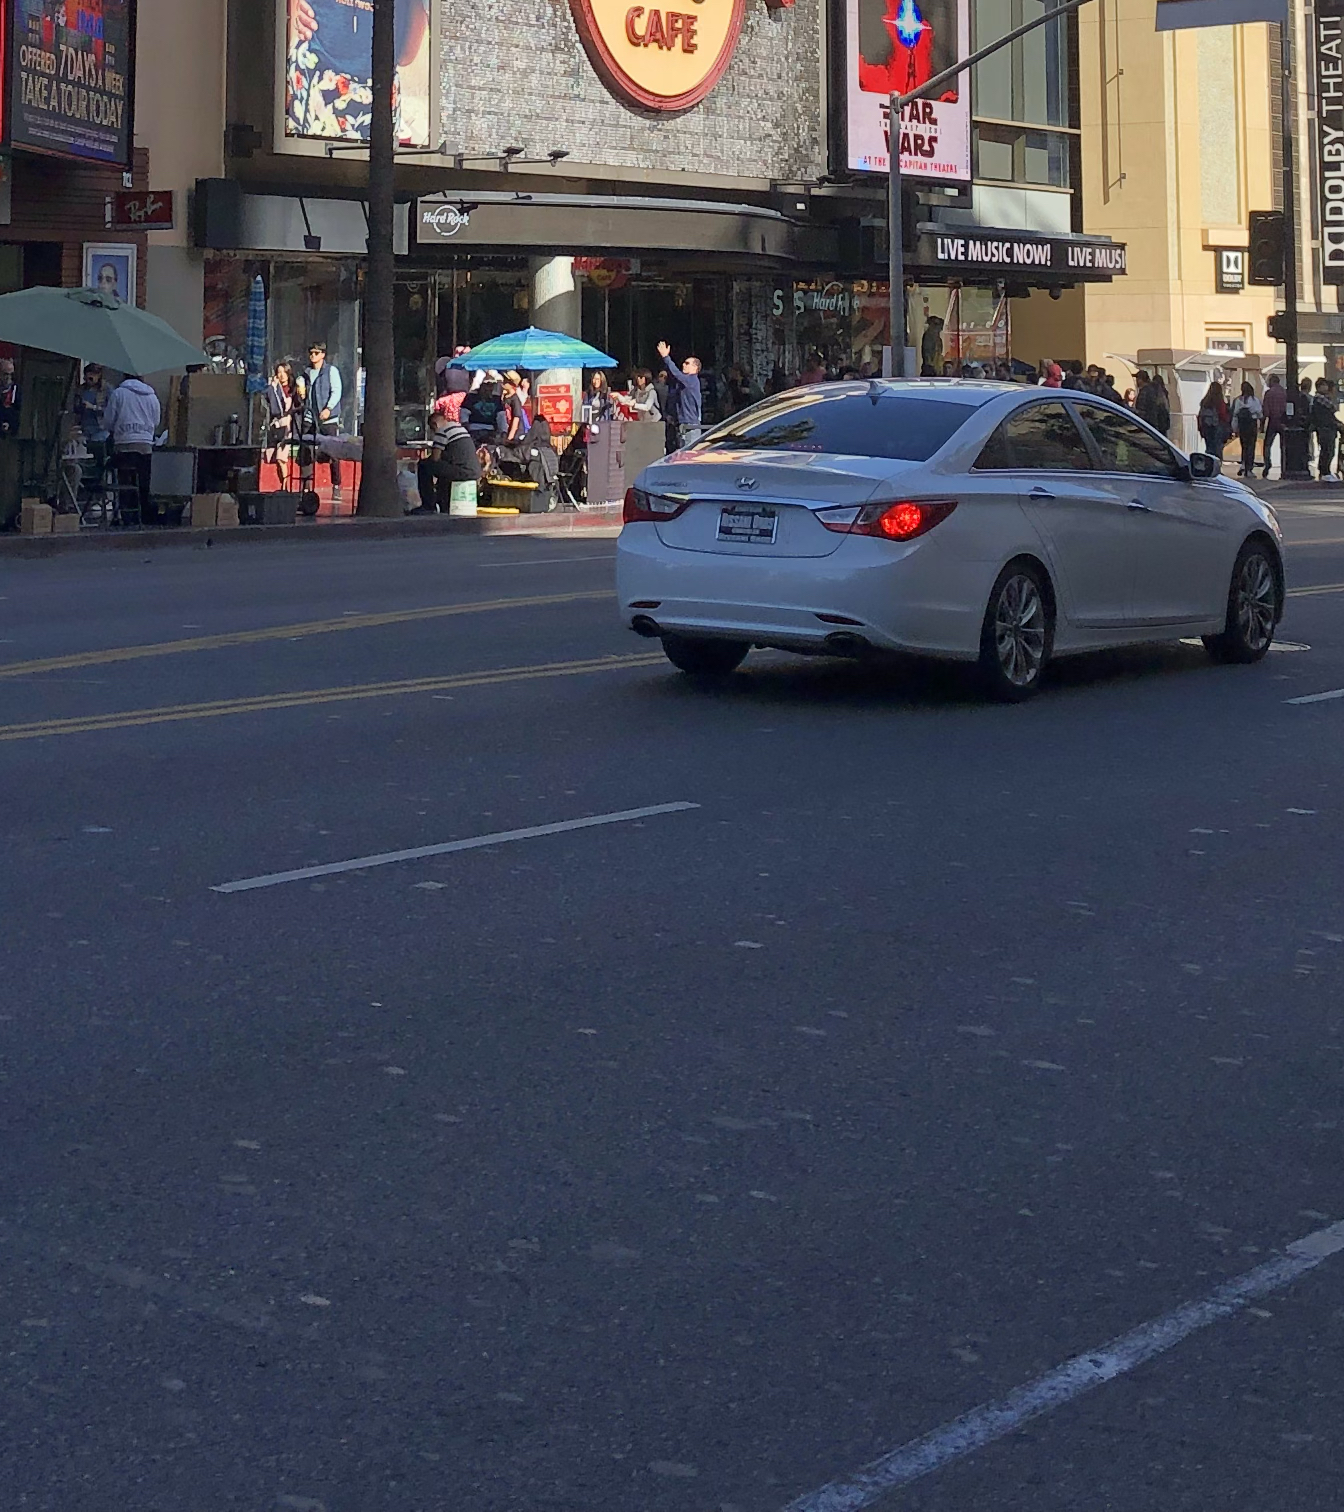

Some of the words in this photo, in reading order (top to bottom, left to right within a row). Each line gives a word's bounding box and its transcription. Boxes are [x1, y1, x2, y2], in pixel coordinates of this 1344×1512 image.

[625, 5, 699, 54] CAFE
[19, 45, 56, 75] OFFERED
[59, 44, 66, 77] 7
[67, 47, 96, 88] DAYS
[1319, 16, 1344, 118] THEAT
[20, 71, 48, 109] TAKE
[50, 80, 59, 113] A
[60, 82, 88, 121] TOUR
[89, 91, 124, 128] TODAY
[874, 156, 887, 167] THE
[422, 211, 447, 224] Hard
[446, 212, 470, 226] Rock
[936, 238, 965, 261] LIVE
[967, 240, 1012, 264] MUSIC
[1013, 243, 1052, 267] NOW!
[1067, 246, 1093, 267] LIVE
[812, 292, 837, 311] Hard
